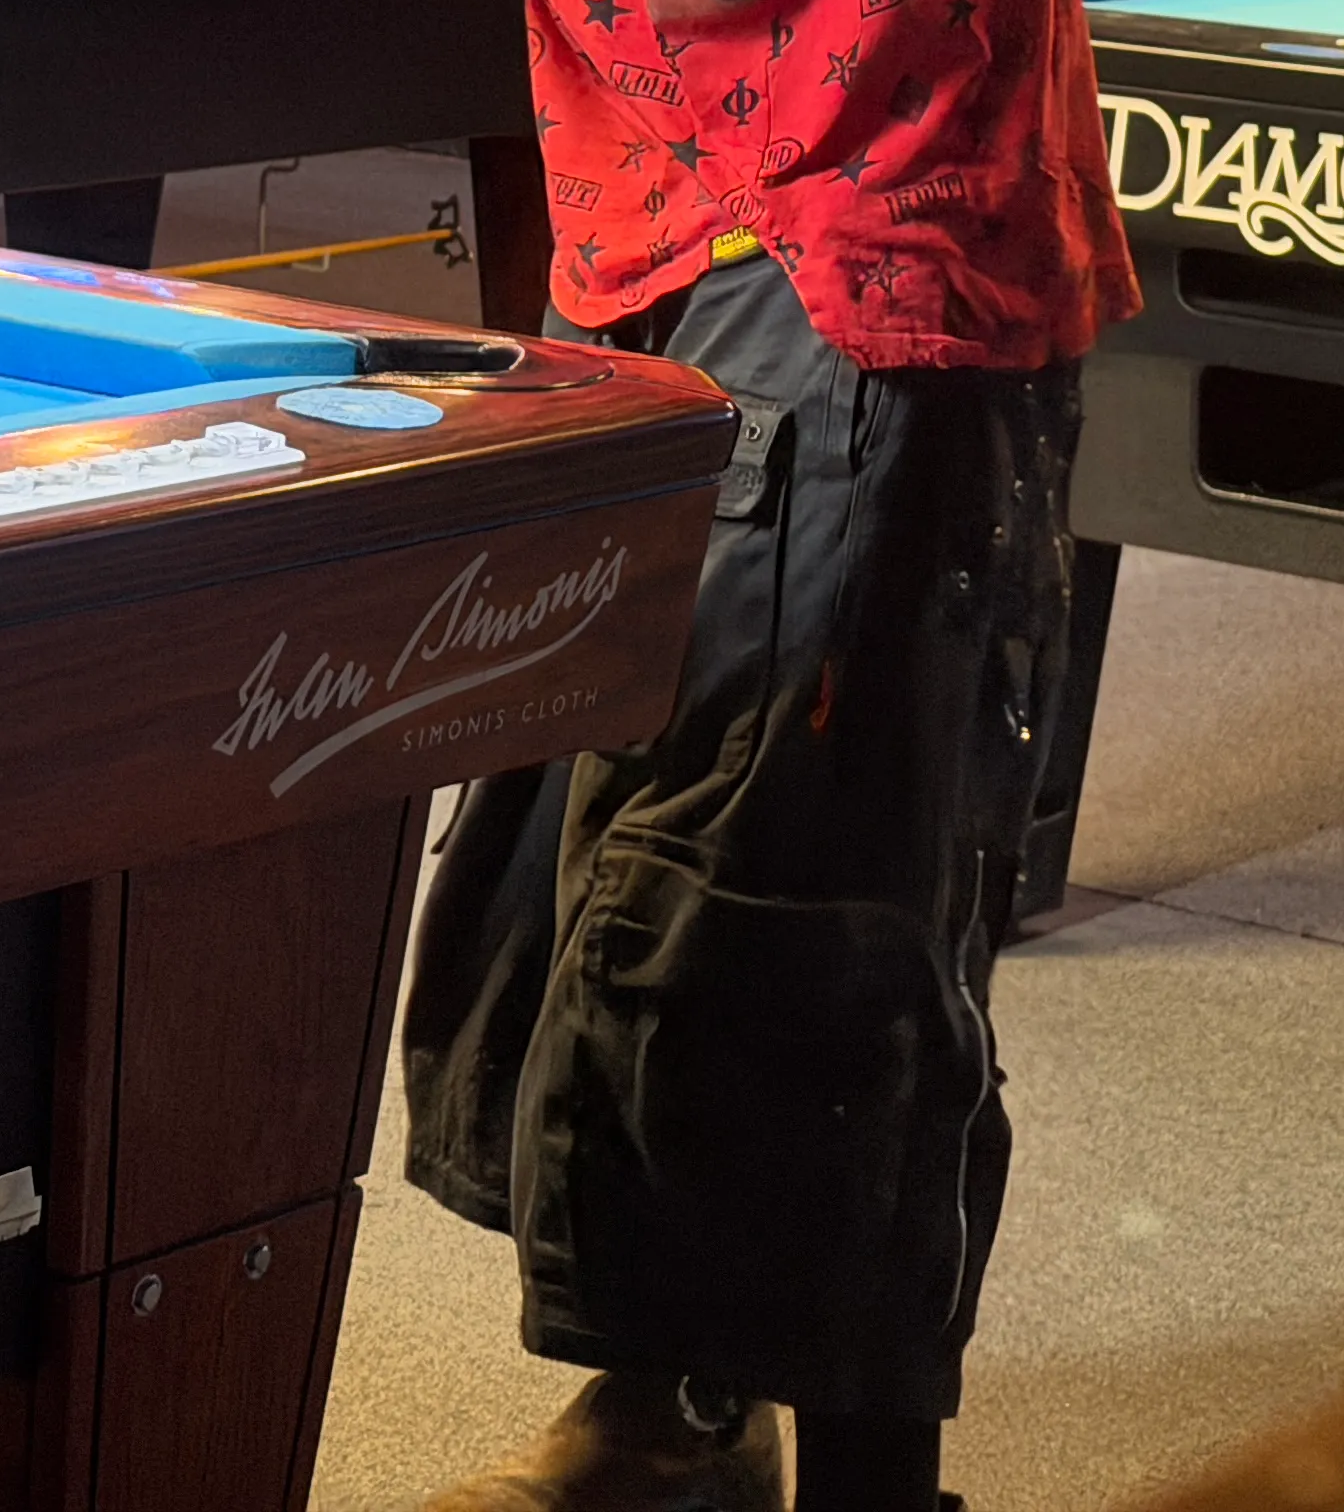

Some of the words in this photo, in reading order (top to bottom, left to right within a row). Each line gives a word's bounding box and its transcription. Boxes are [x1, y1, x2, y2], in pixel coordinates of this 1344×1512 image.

[386, 536, 628, 692] Simonis
[401, 708, 506, 753] SIMONIS
[521, 687, 600, 721] CLOTH
